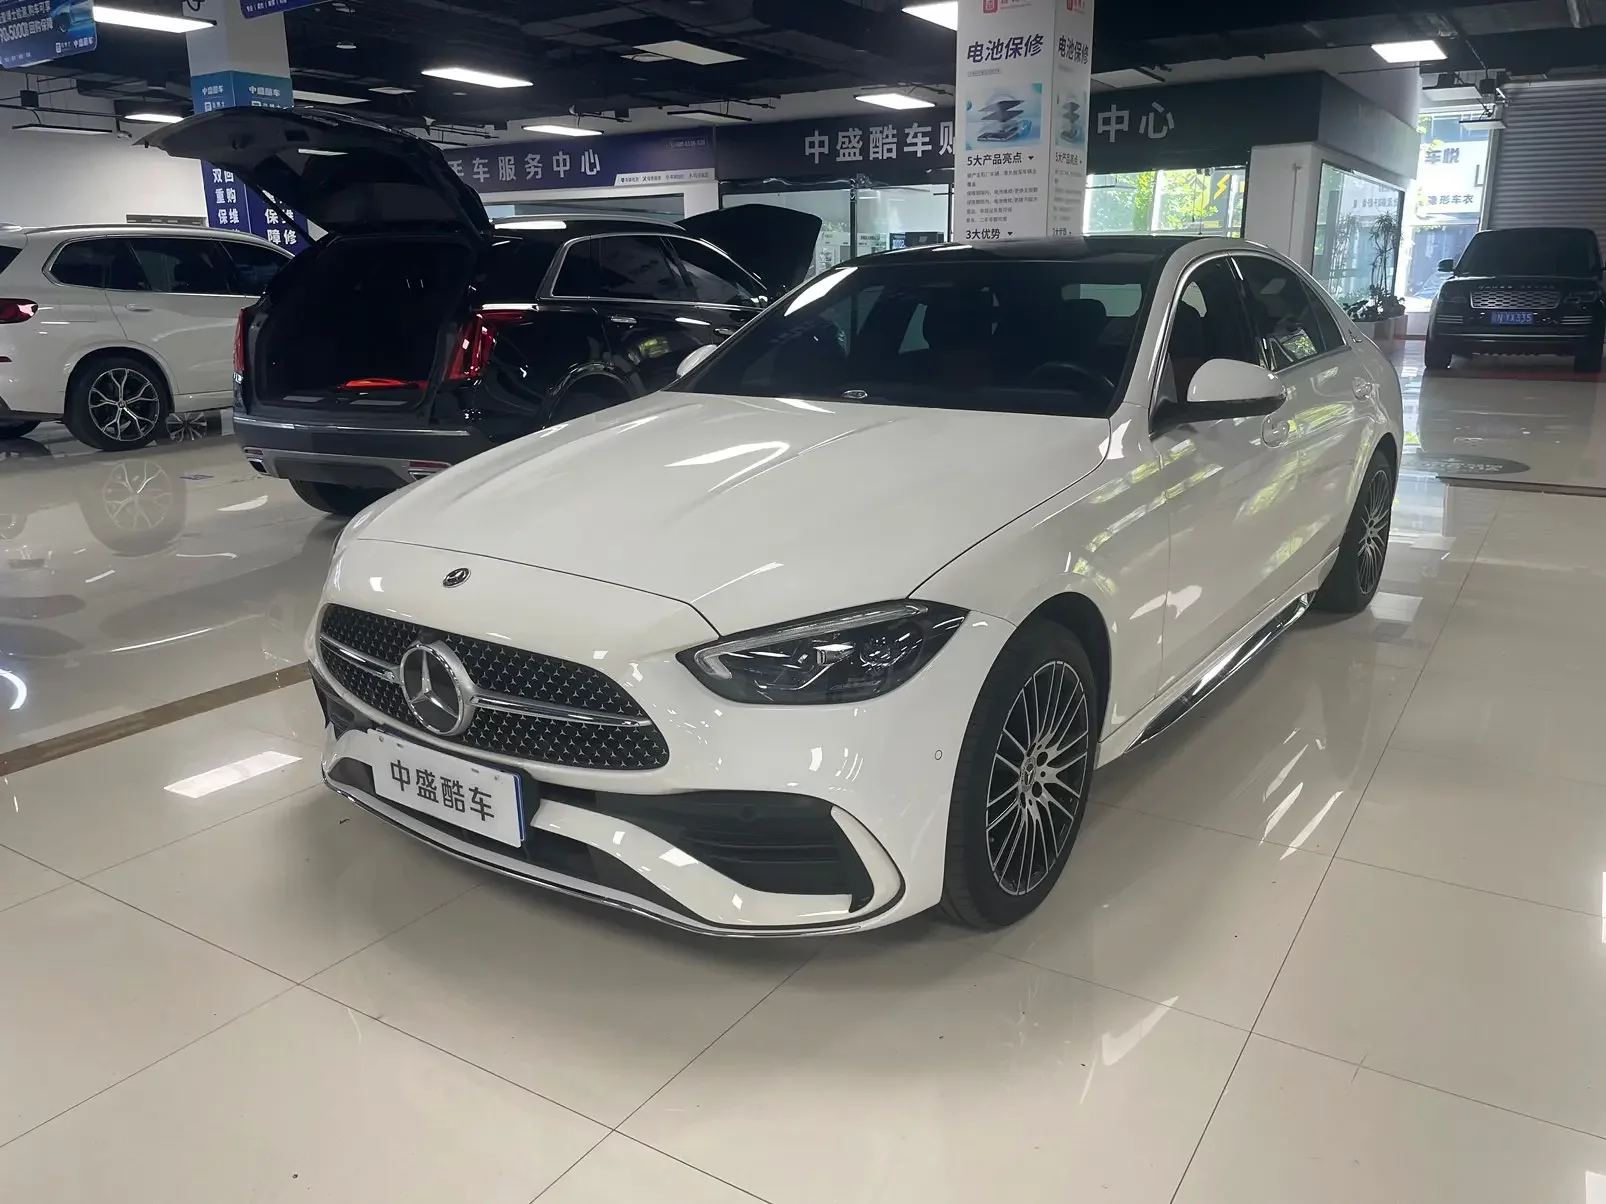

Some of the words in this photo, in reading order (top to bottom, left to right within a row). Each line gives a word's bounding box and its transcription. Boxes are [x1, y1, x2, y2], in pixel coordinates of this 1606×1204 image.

[967, 34, 1044, 63] 电池保修
[1058, 35, 1089, 65] 电池保修
[1097, 101, 1175, 143] 中心
[967, 152, 1022, 167] 5大产品亮点
[965, 228, 1000, 240] 3大优势
[390, 759, 495, 822] 中盛酷车
